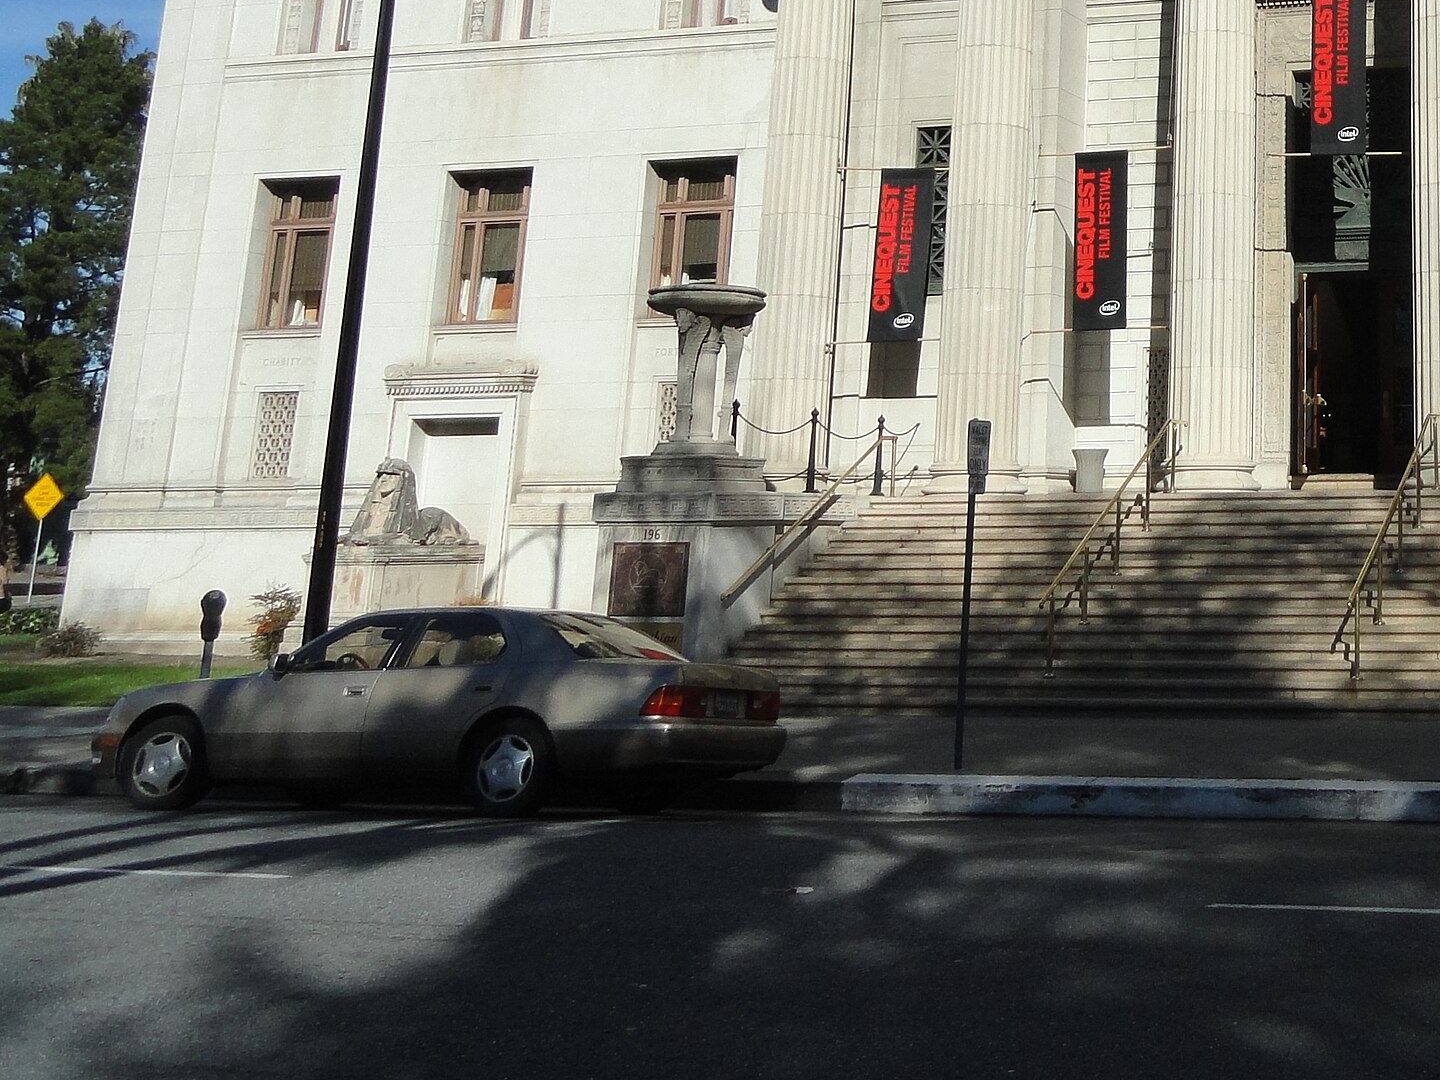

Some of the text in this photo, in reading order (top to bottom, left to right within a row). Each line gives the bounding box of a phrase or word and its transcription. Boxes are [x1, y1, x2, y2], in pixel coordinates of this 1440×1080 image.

[1337, 54, 1349, 85] FILM
[871, 183, 901, 312] CINEQUEST
[897, 185, 918, 273] FILM FESTIVAL
[1076, 168, 1096, 300] CINEQUEST
[1098, 167, 1112, 259] FILM FESTIVAL
[643, 528, 661, 540] 196
